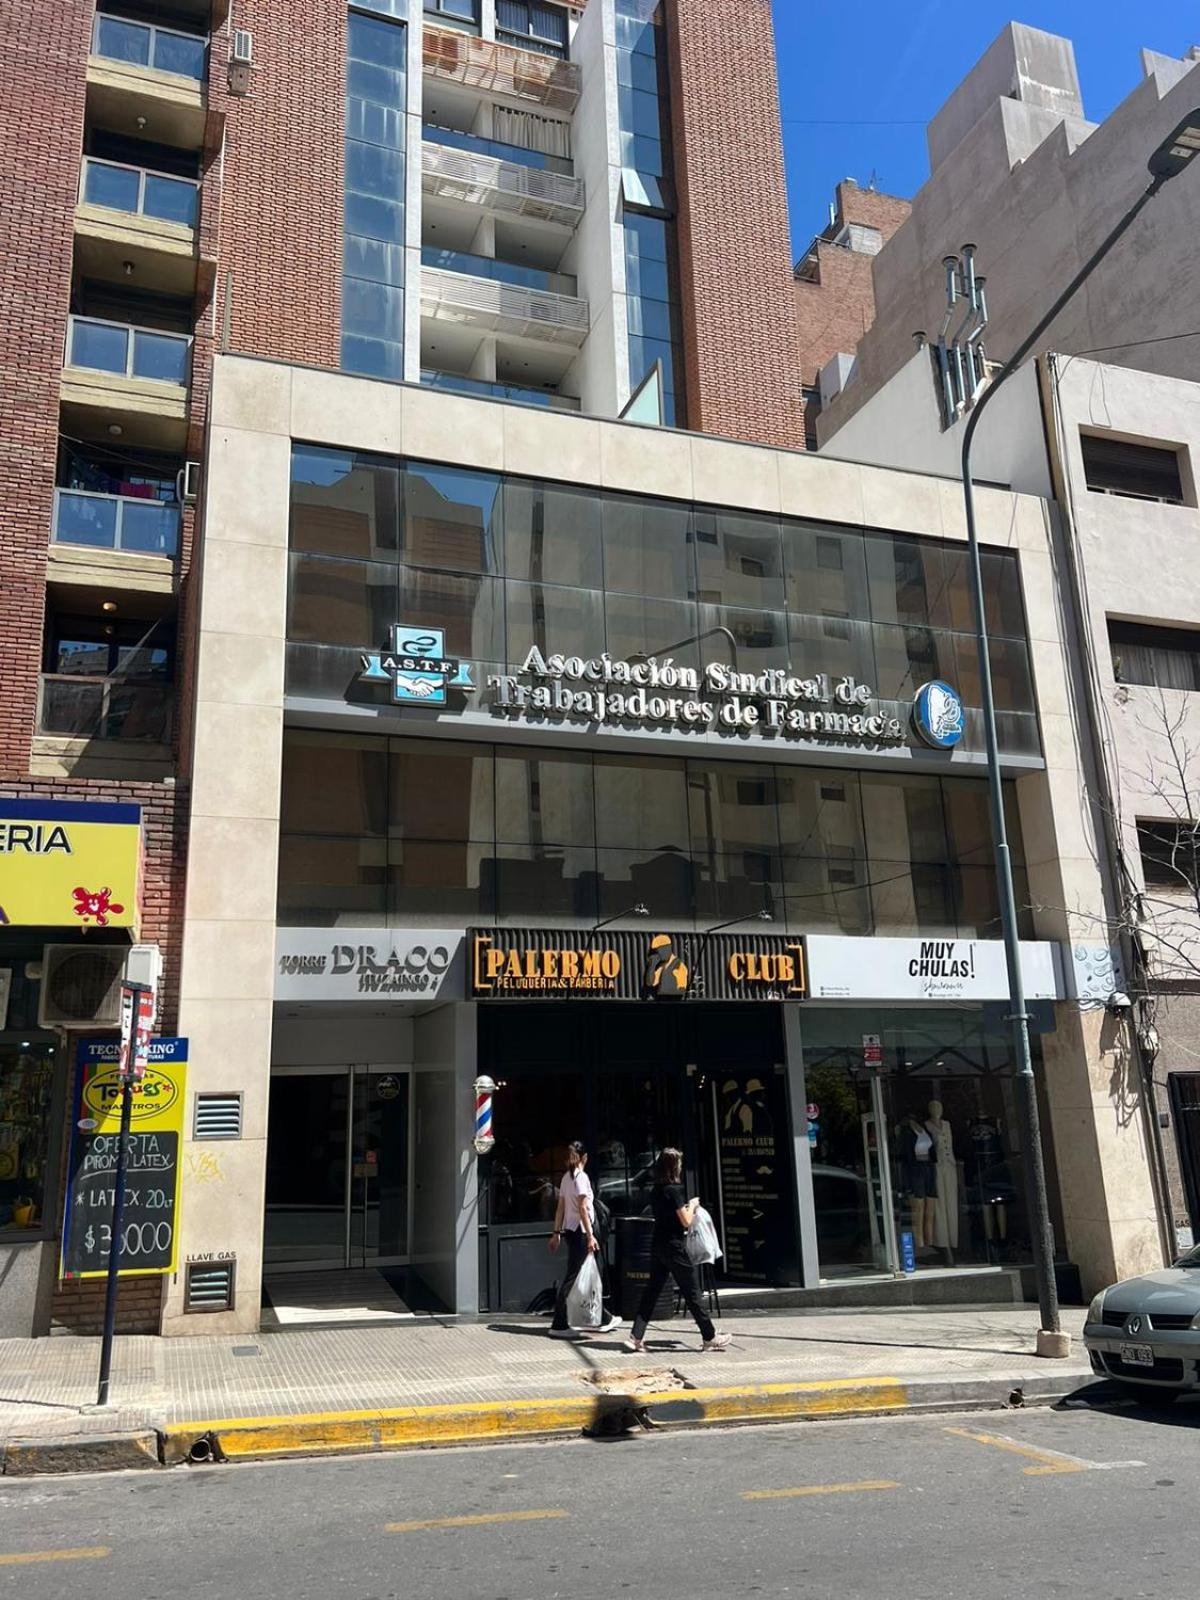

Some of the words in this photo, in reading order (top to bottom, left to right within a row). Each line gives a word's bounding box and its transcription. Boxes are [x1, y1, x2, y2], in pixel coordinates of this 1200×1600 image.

[382, 657, 457, 673] A.S.T.F.
[518, 645, 698, 691] Asociación
[706, 662, 832, 703] Sindical
[835, 676, 871, 706] de
[487, 674, 714, 723] Trabajadores
[720, 697, 759, 726] de
[765, 700, 906, 739] Farmacia
[920, 942, 955, 959] MUY
[281, 955, 326, 973] TORRE
[331, 945, 450, 974] DRACO
[486, 948, 620, 978] PALERMO
[729, 952, 795, 982] CLUB
[497, 977, 557, 988] PELUQUERIA
[133, 1153, 170, 1167] LATEX
[186, 1252, 214, 1262] LLAVE
[218, 1251, 237, 1260] GAS
